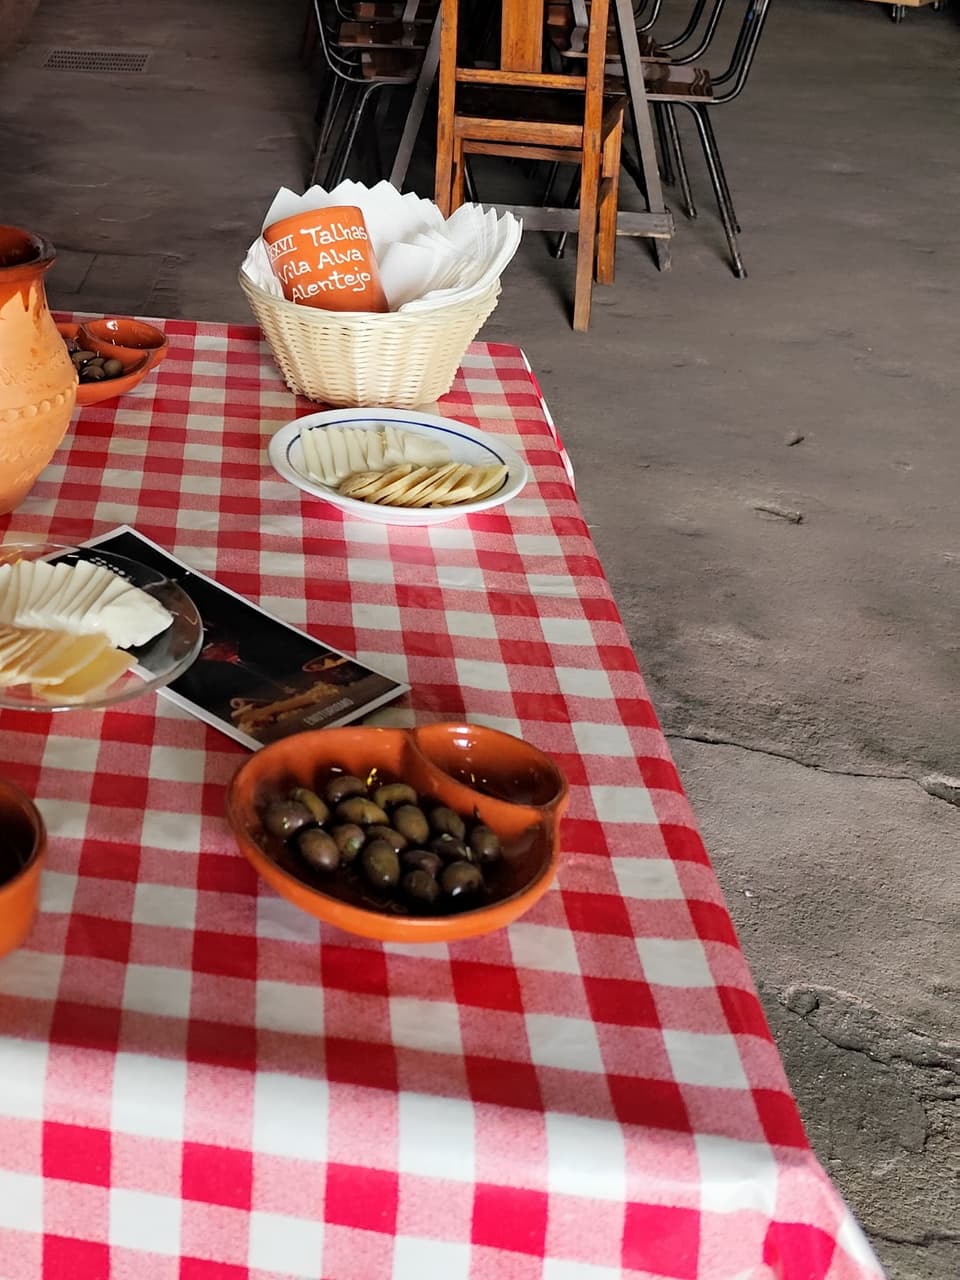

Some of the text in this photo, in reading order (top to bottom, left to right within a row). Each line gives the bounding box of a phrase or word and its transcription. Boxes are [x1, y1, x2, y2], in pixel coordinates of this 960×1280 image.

[299, 223, 368, 247] Talhas
[278, 249, 365, 285] Vila Alva
[290, 267, 371, 304] Alentejo
